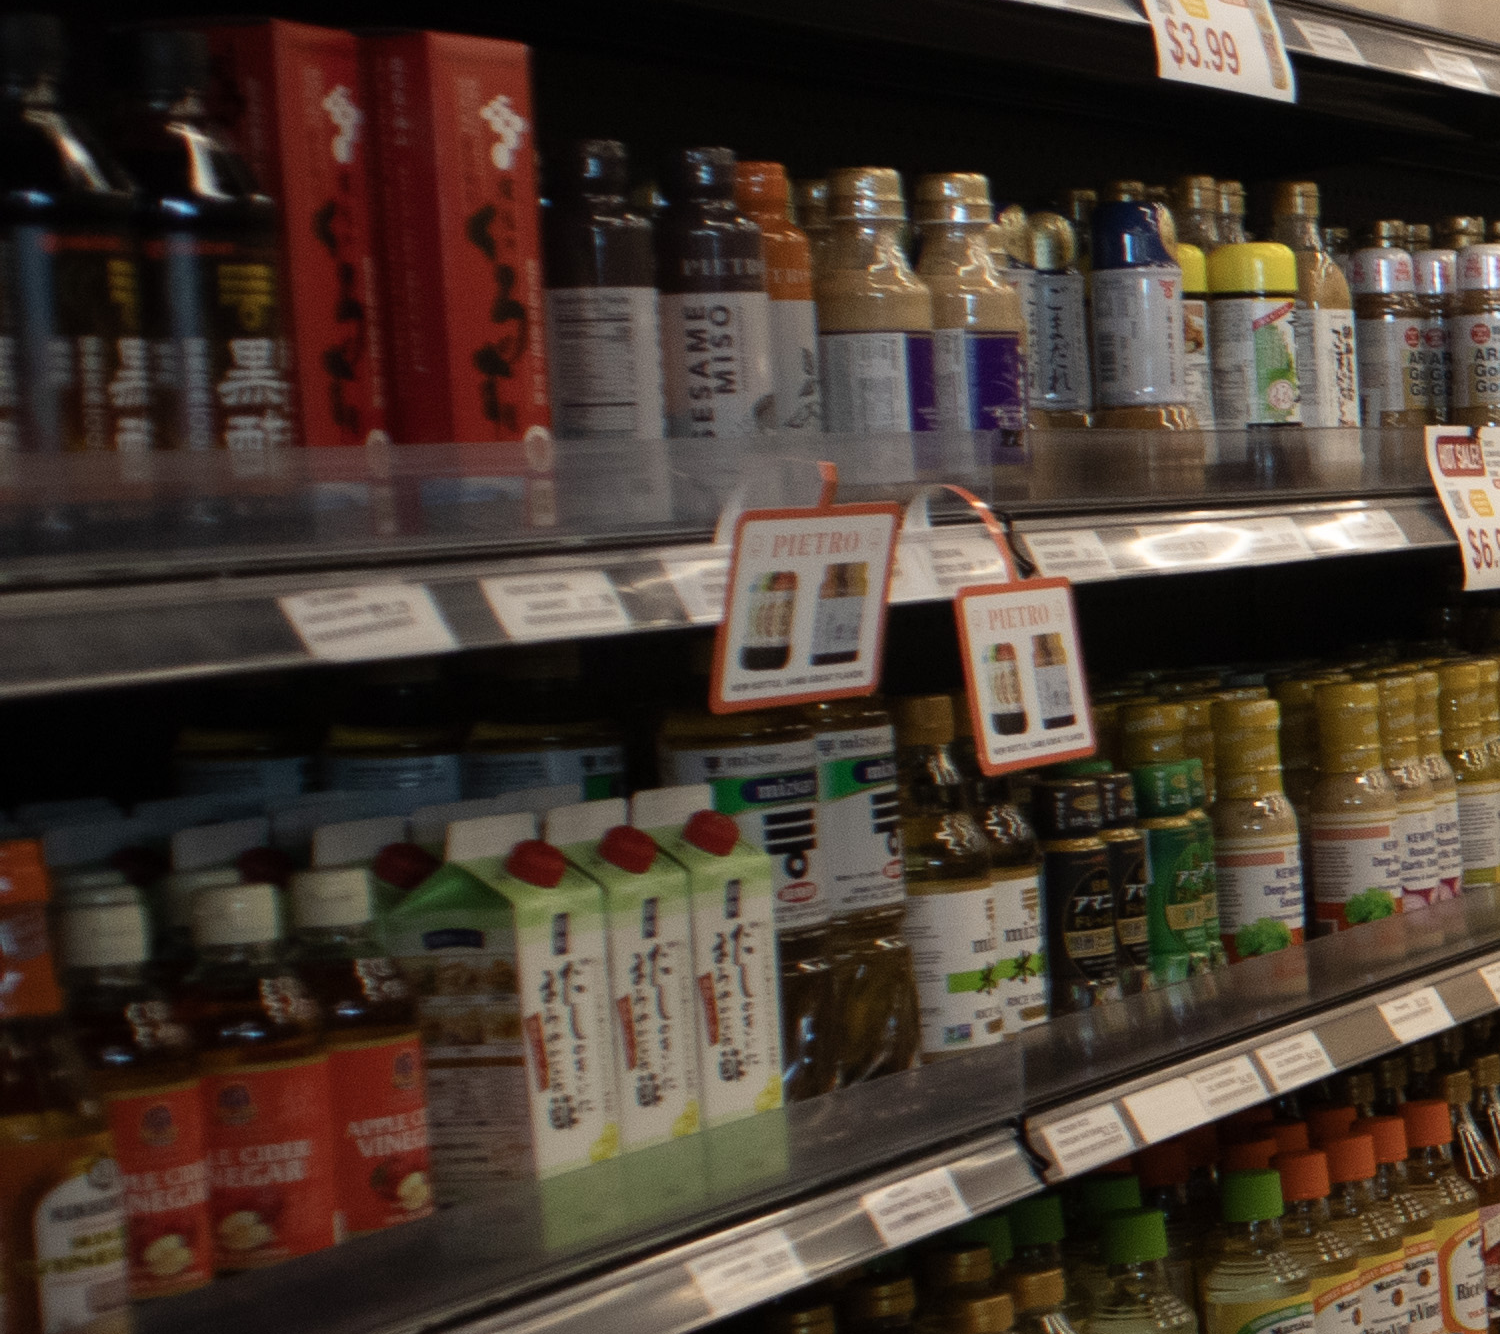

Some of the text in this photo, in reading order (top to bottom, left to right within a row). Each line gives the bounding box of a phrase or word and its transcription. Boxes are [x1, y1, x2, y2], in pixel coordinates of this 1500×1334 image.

[1166, 19, 1241, 76] $3.99
[711, 304, 737, 395] MISO
[772, 530, 859, 558] PIETRO
[986, 604, 1050, 631] PIETRO
